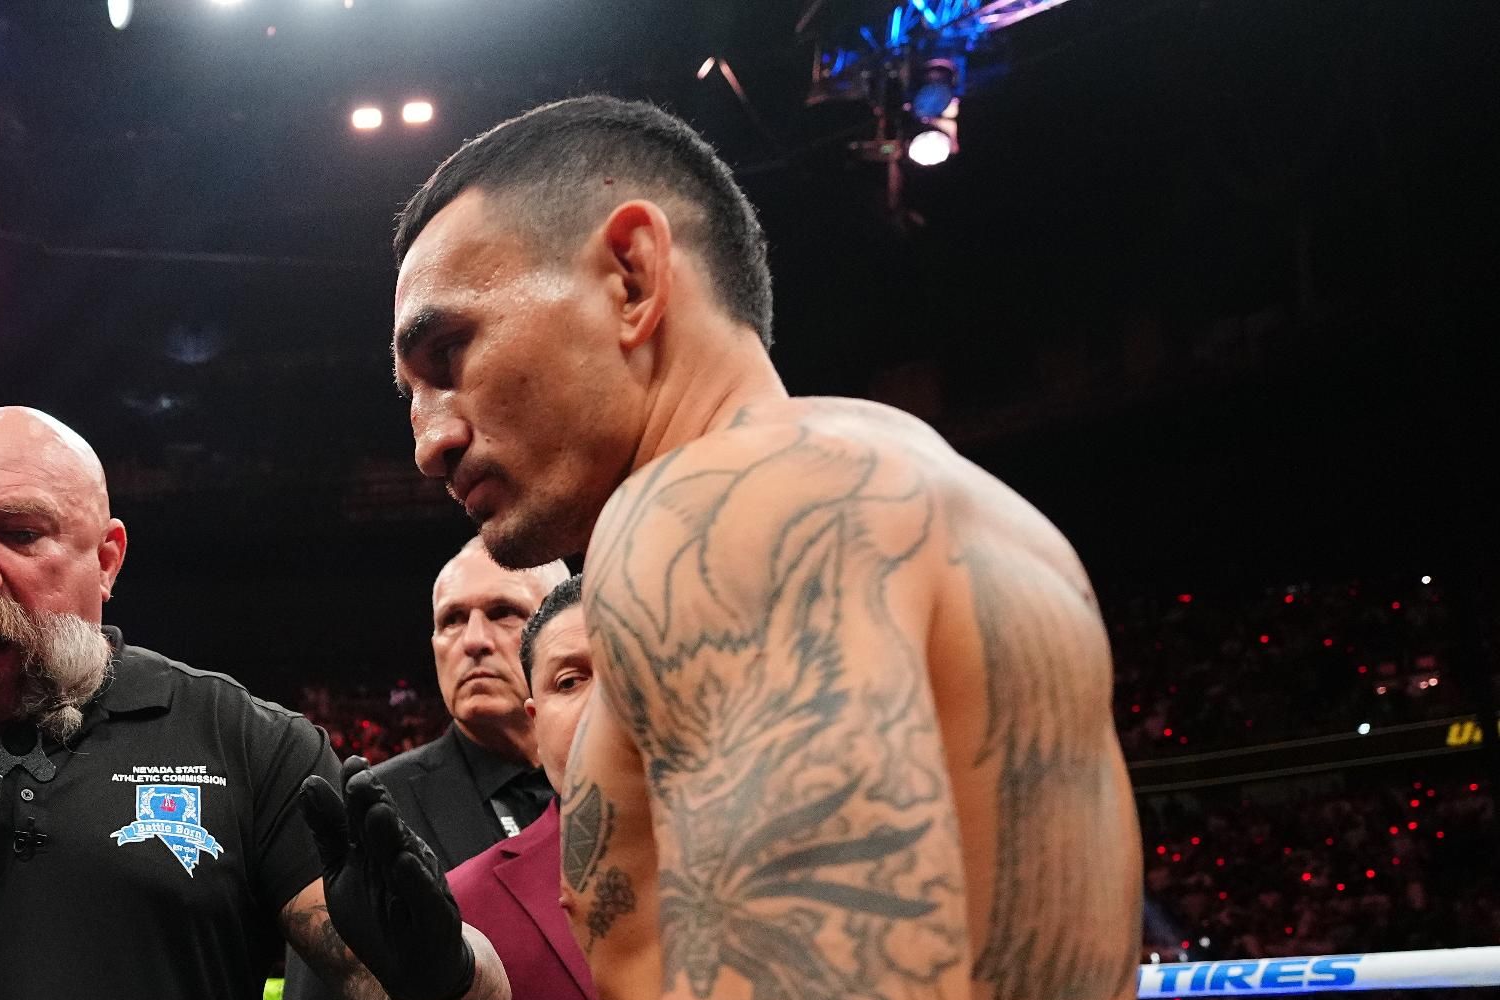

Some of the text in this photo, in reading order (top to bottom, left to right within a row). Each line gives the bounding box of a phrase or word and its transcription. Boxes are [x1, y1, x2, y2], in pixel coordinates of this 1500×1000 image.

[132, 765, 207, 774] NEVADA STATE
[111, 773, 228, 787] ATHLETIC COMMISSION
[137, 822, 203, 838] Battle Born
[1156, 956, 1365, 994] TIRES
